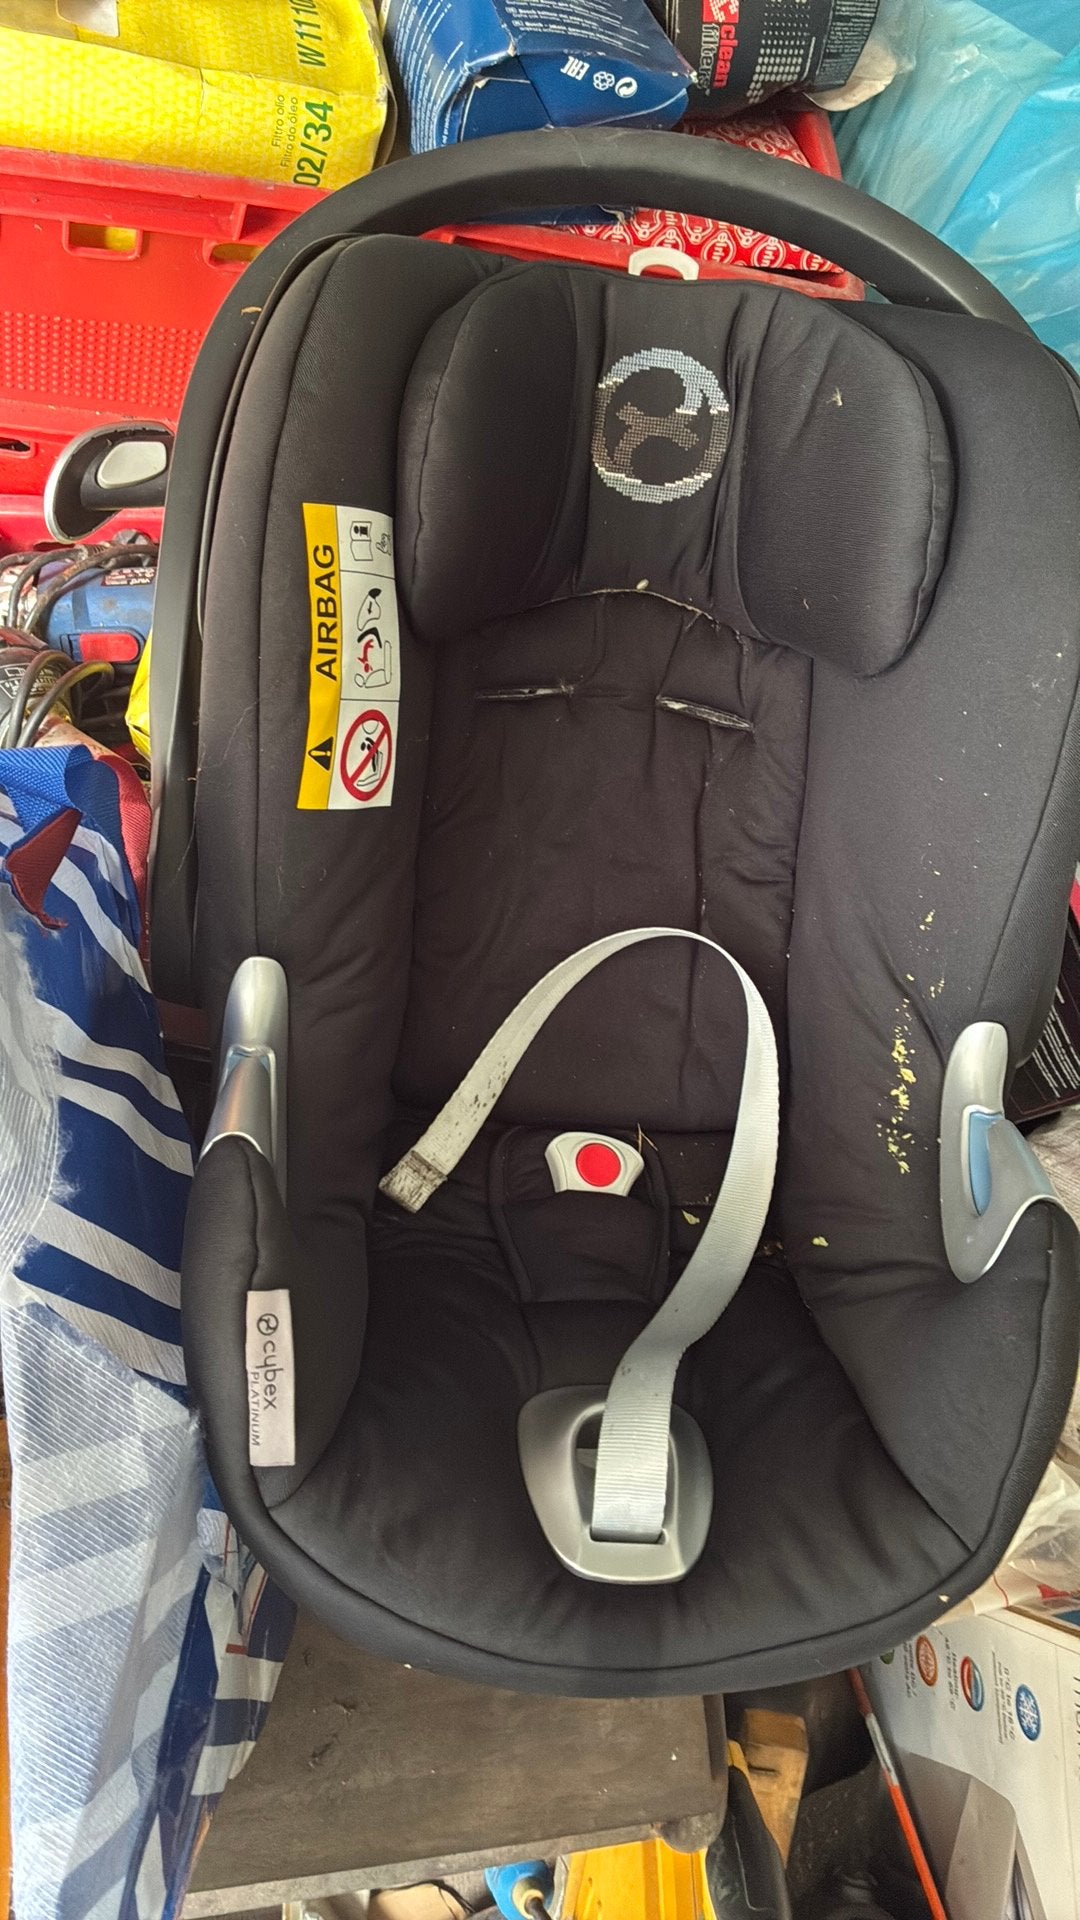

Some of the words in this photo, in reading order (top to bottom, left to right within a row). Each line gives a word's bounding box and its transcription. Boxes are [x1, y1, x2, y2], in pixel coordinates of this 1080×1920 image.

[697, 23, 720, 89] filters
[712, 24, 738, 88] clean
[272, 118, 284, 147] Filtro
[275, 94, 285, 115] olio
[281, 143, 294, 167] Filtro
[288, 126, 296, 142] do
[313, 545, 337, 681] AIRBAG
[256, 1340, 284, 1410] cybex
[250, 1371, 261, 1446] PLATINUM
